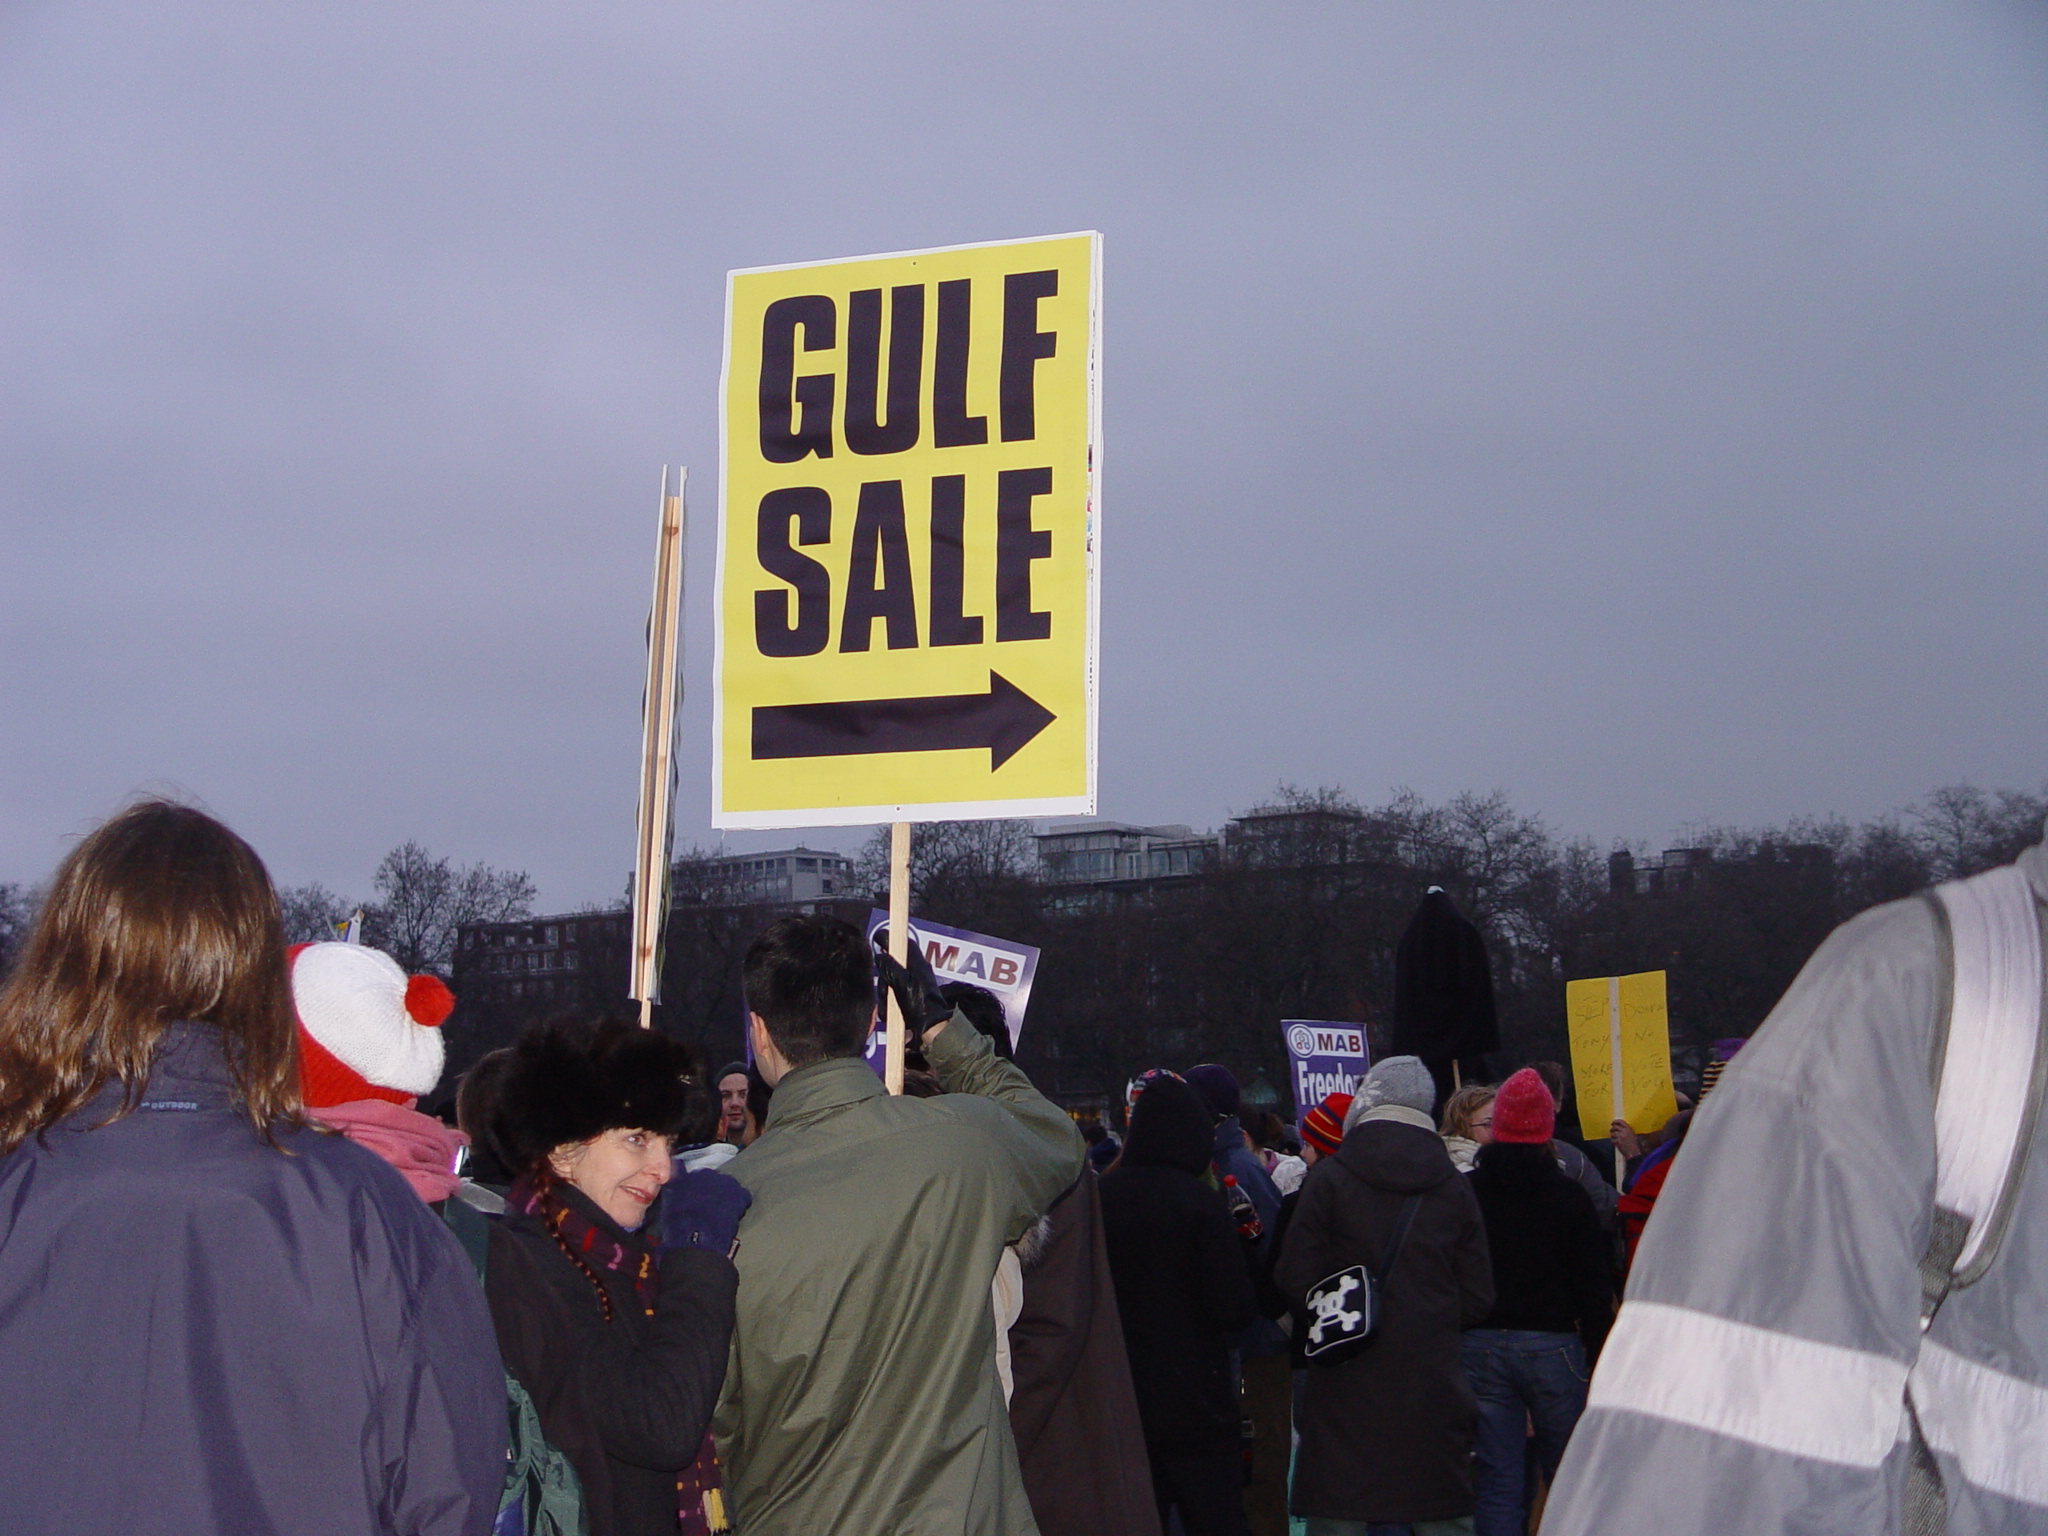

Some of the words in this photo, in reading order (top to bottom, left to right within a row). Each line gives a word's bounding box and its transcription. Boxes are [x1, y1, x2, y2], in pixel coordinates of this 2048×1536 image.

[759, 269, 1059, 463] GULF
[753, 466, 1053, 658] SALE
[924, 940, 1020, 986] MAB
[1317, 1033, 1361, 1052] MAB
[151, 1101, 198, 1110] OUTDOOR
